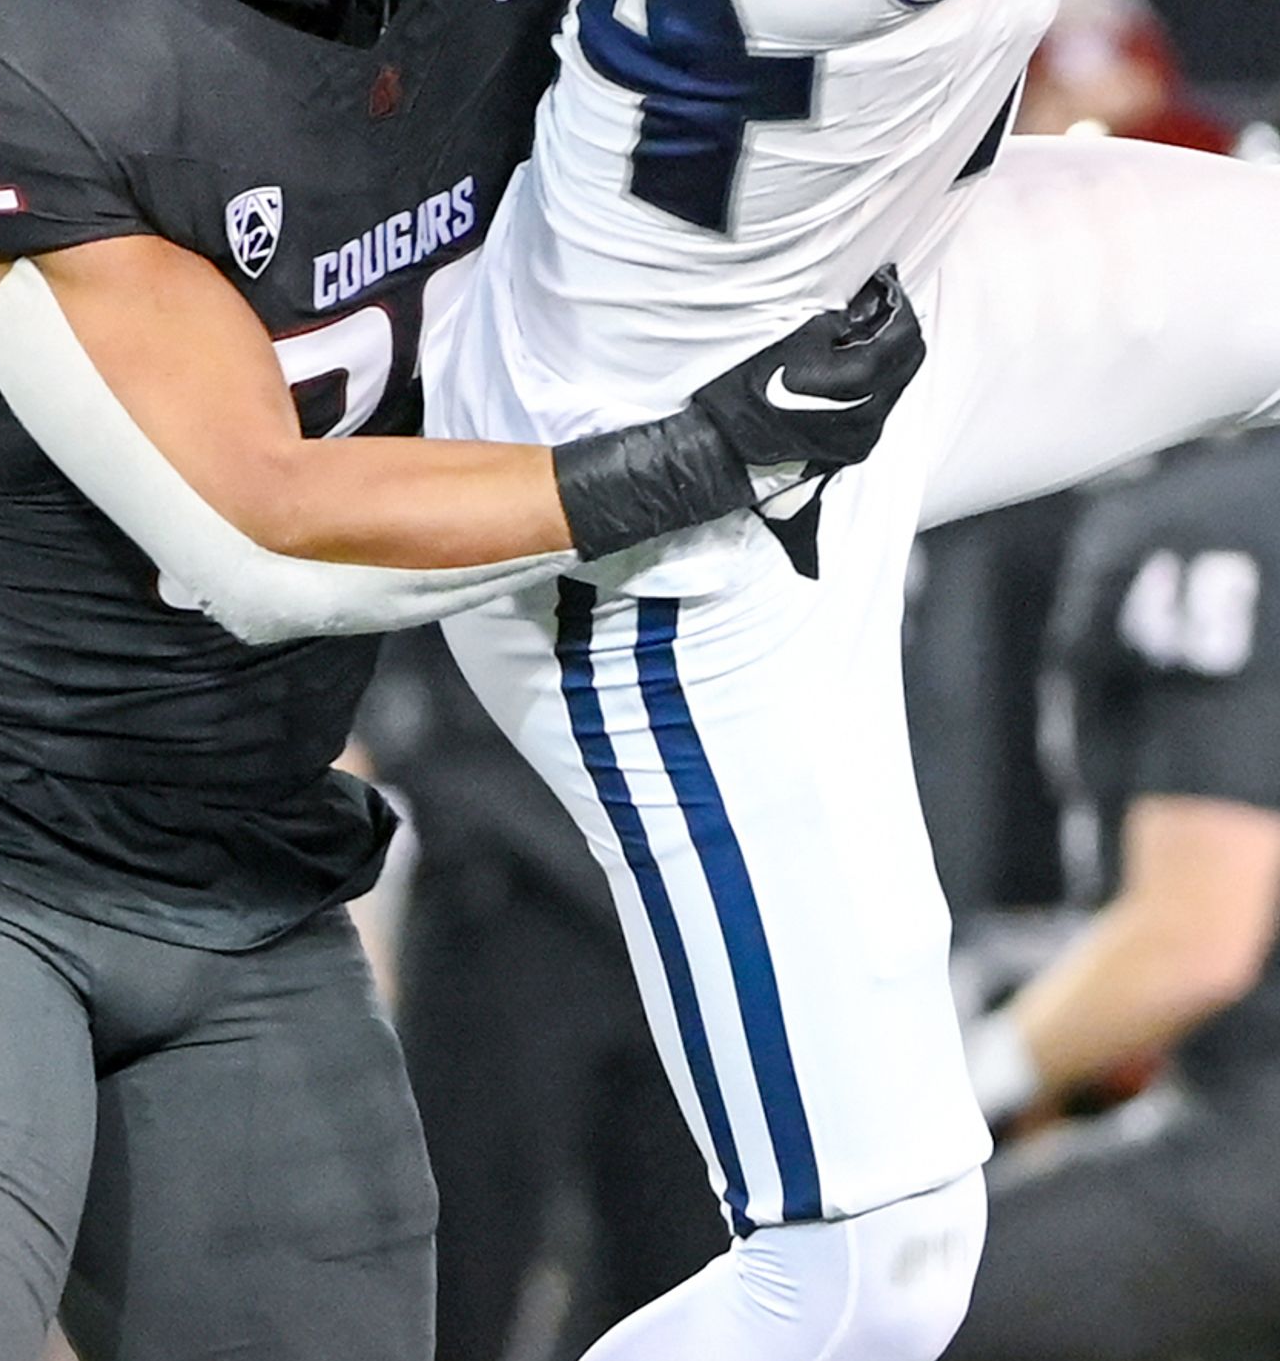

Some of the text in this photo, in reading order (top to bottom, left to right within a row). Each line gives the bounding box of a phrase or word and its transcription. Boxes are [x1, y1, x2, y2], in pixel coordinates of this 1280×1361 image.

[226, 190, 280, 244] PAC
[241, 225, 272, 263] 12
[312, 175, 476, 311] COUGARS
